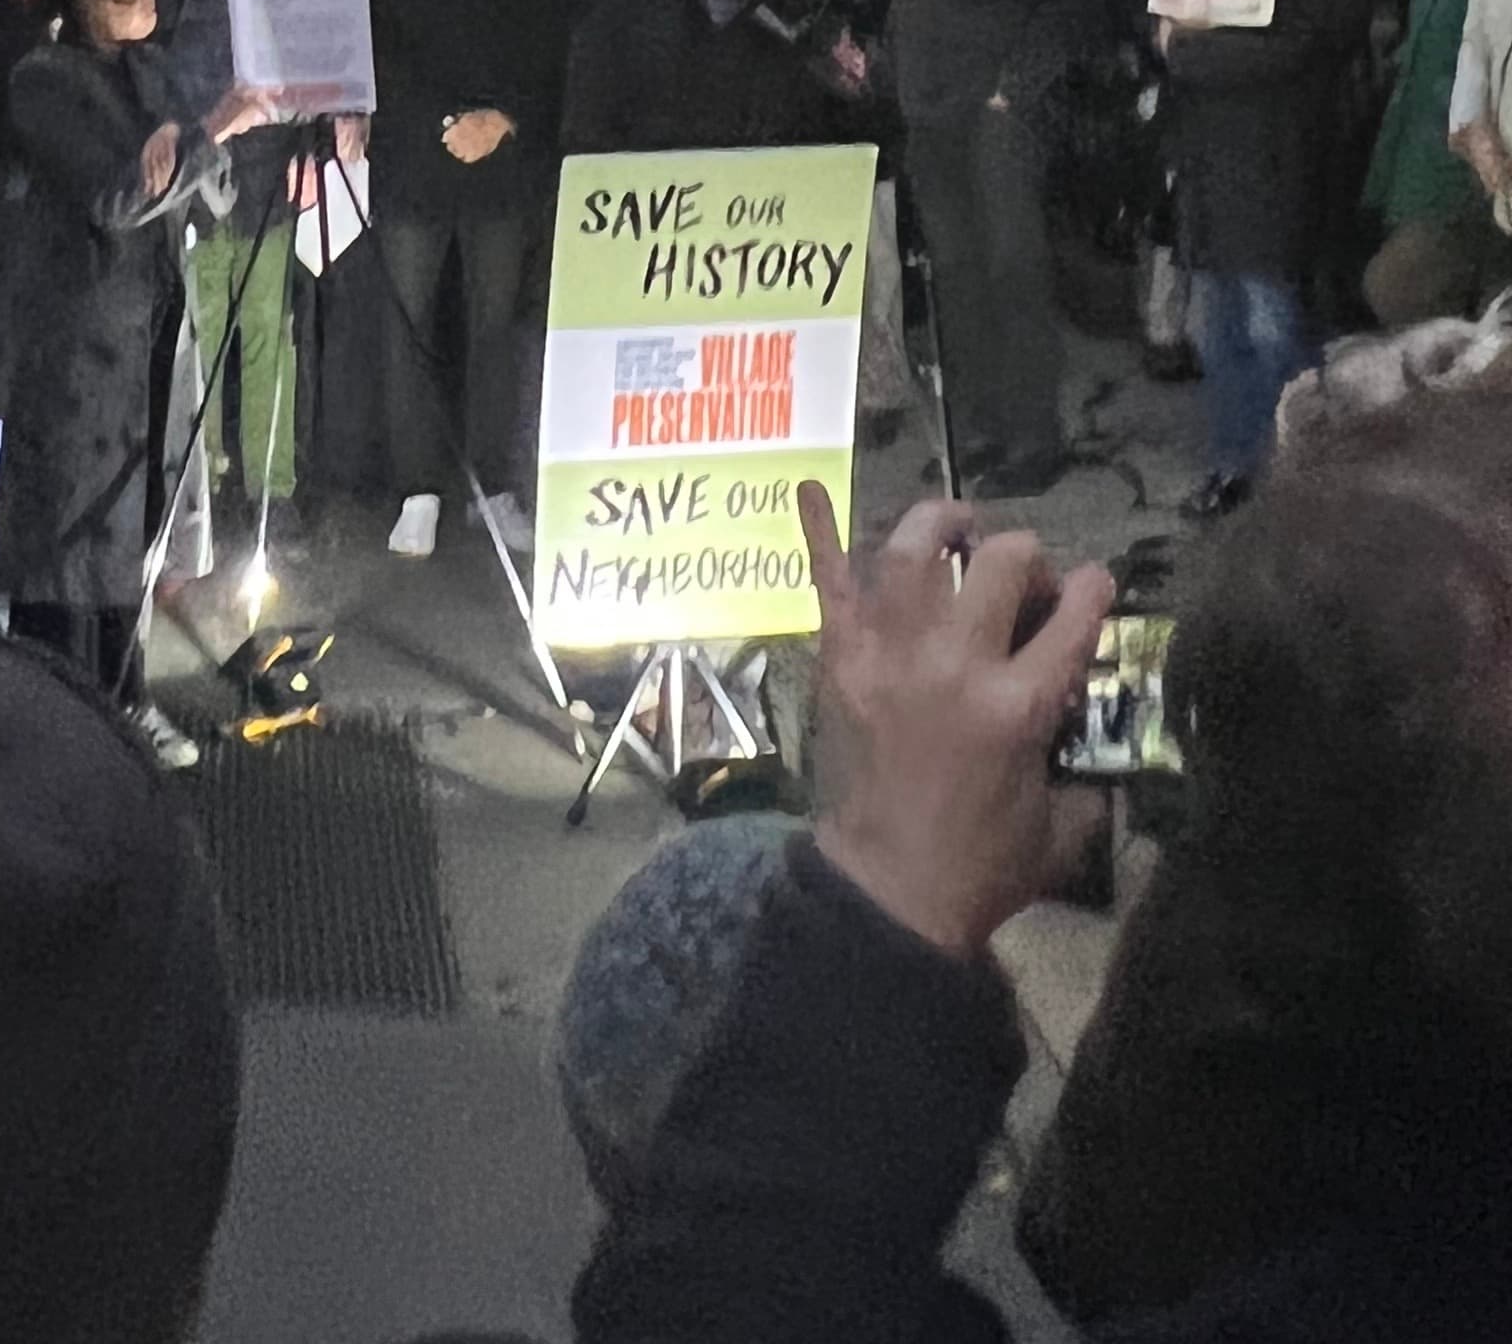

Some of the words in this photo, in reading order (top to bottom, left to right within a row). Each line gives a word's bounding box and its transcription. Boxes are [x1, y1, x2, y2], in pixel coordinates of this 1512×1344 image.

[580, 182, 704, 241] SAVE
[726, 194, 786, 229] OUR
[642, 238, 853, 307] HISTORY
[585, 472, 711, 536] SAVE
[726, 478, 790, 519] OUR
[548, 544, 805, 606] NEIGHBORHOO
